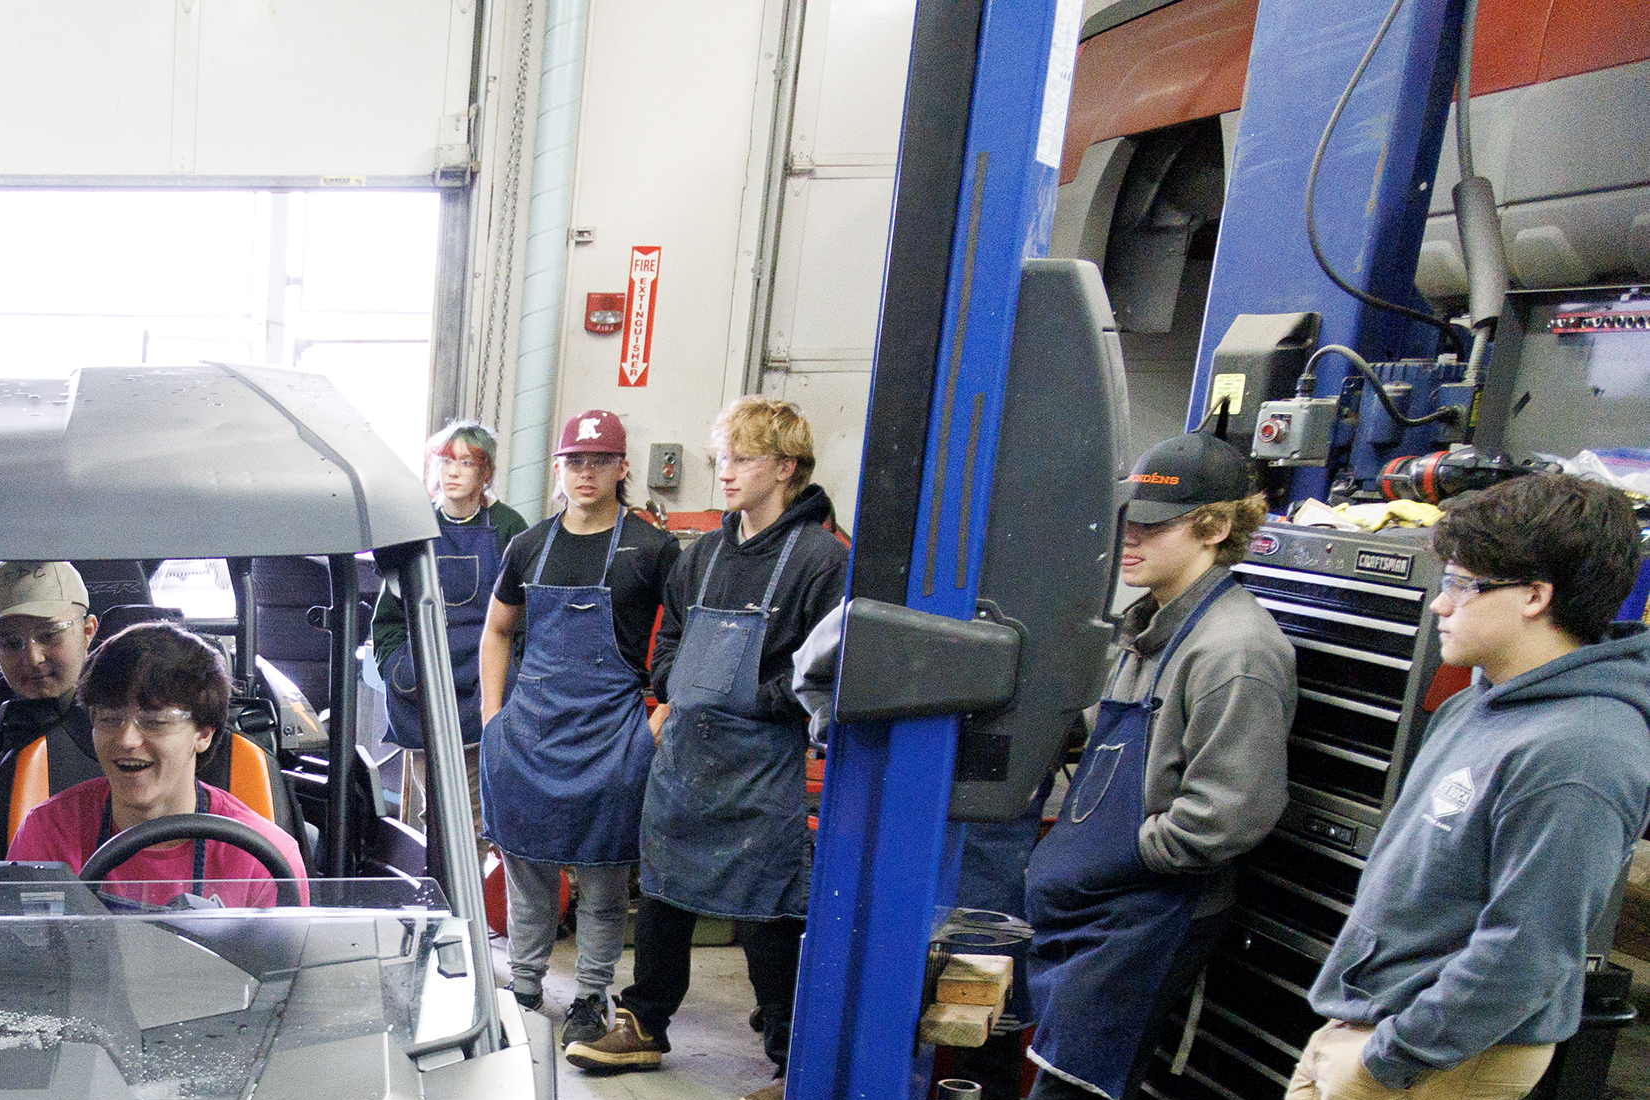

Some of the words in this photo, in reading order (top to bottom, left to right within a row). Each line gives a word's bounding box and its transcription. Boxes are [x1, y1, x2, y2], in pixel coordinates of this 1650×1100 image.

[634, 259, 656, 272] FIRE
[630, 277, 647, 376] EXTINGUISHER
[1358, 554, 1408, 574] CRAFTSMAN
